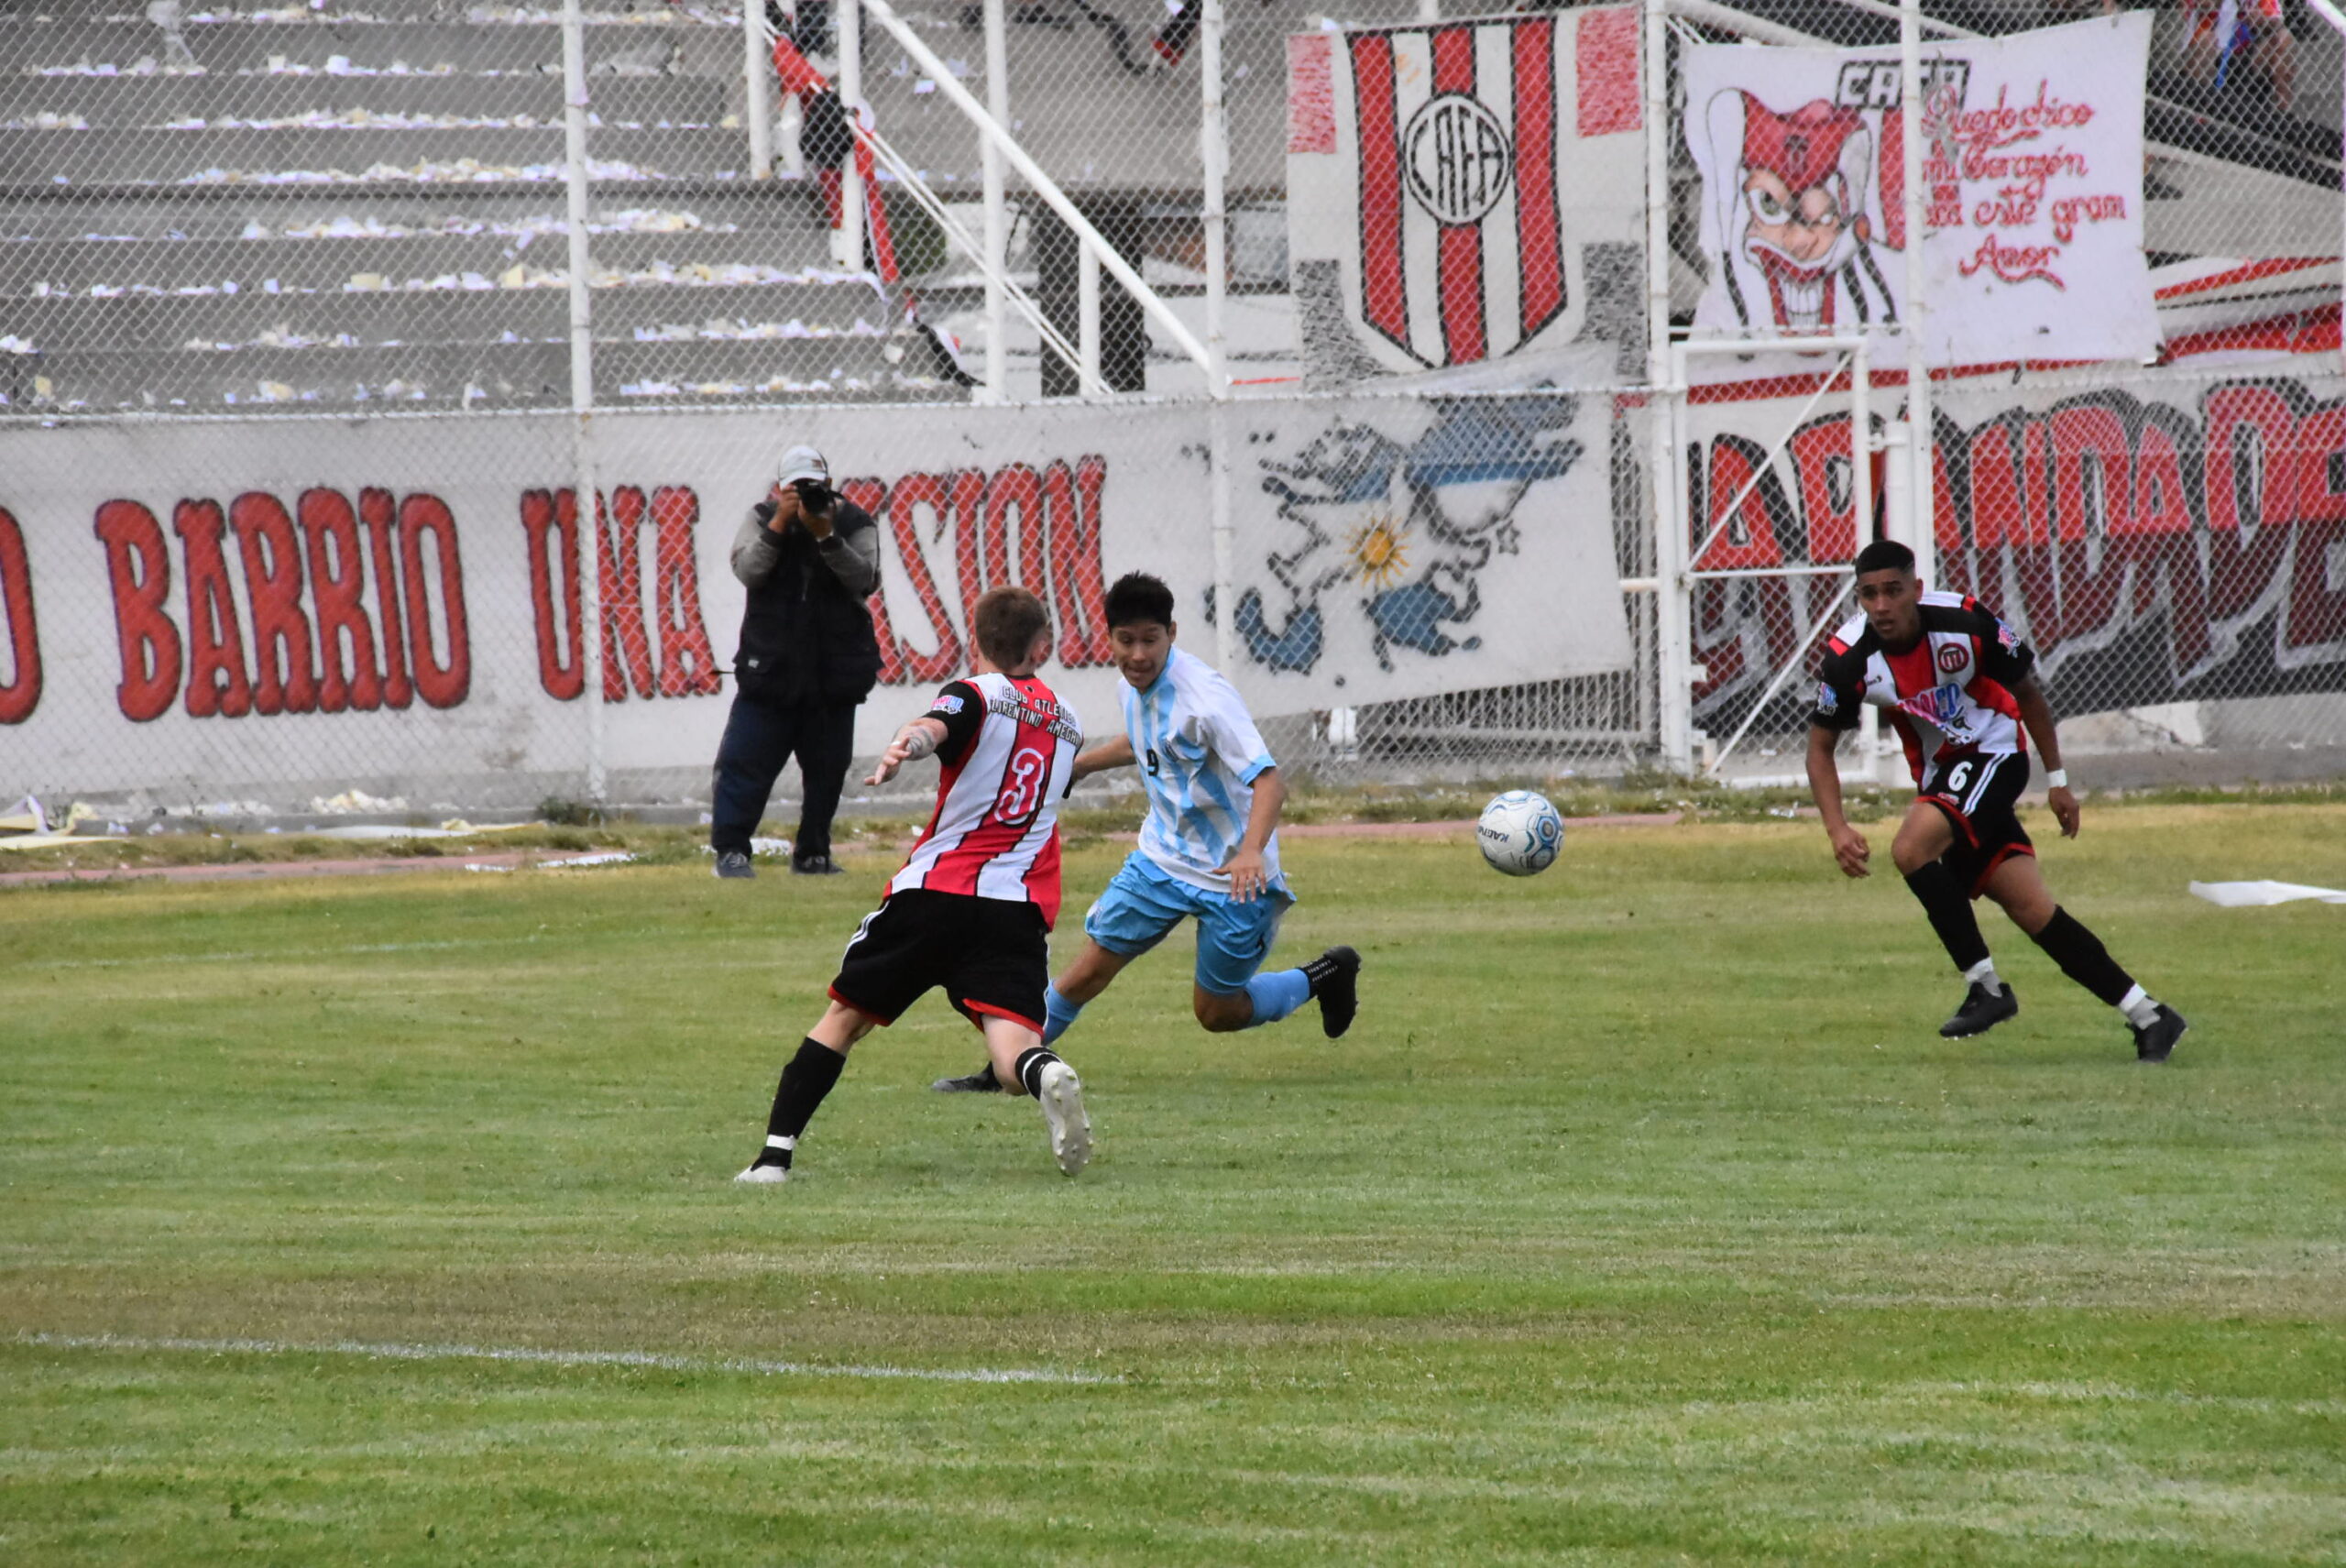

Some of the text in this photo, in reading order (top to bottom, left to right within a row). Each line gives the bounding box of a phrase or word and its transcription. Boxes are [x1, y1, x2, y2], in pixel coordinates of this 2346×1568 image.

[94, 486, 471, 722] BARRIO
[521, 485, 722, 703] UNA
[767, 453, 1120, 686] SION
[1002, 685, 1028, 705] CLUB
[1146, 748, 1159, 777] 9
[1948, 761, 1973, 792] 6
[993, 747, 1044, 826] 3
